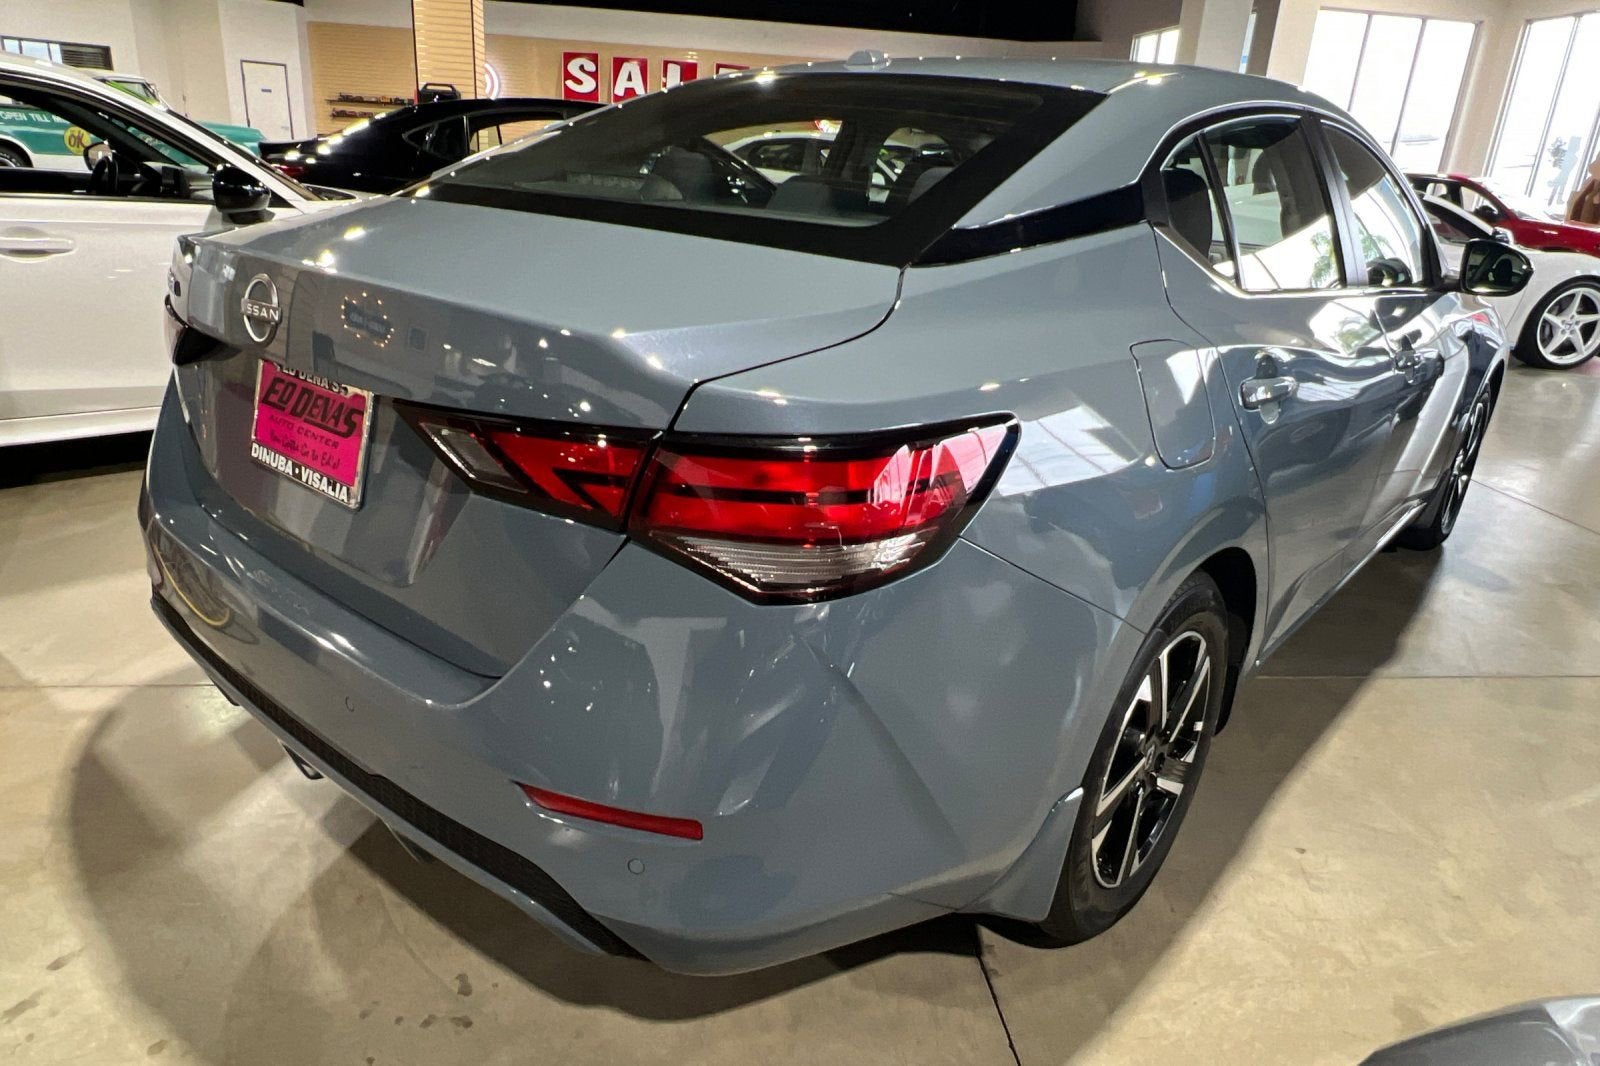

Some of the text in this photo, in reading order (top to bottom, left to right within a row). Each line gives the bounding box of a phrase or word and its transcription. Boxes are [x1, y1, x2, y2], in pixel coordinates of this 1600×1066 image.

[0, 111, 28, 121] OPEN
[29, 113, 51, 122] TILL
[68, 131, 86, 149] OK
[245, 302, 279, 321] SSAN
[261, 376, 297, 411] ED
[268, 414, 340, 449] AUTO CENTER
[251, 442, 348, 503] DINUBA VISALIA
